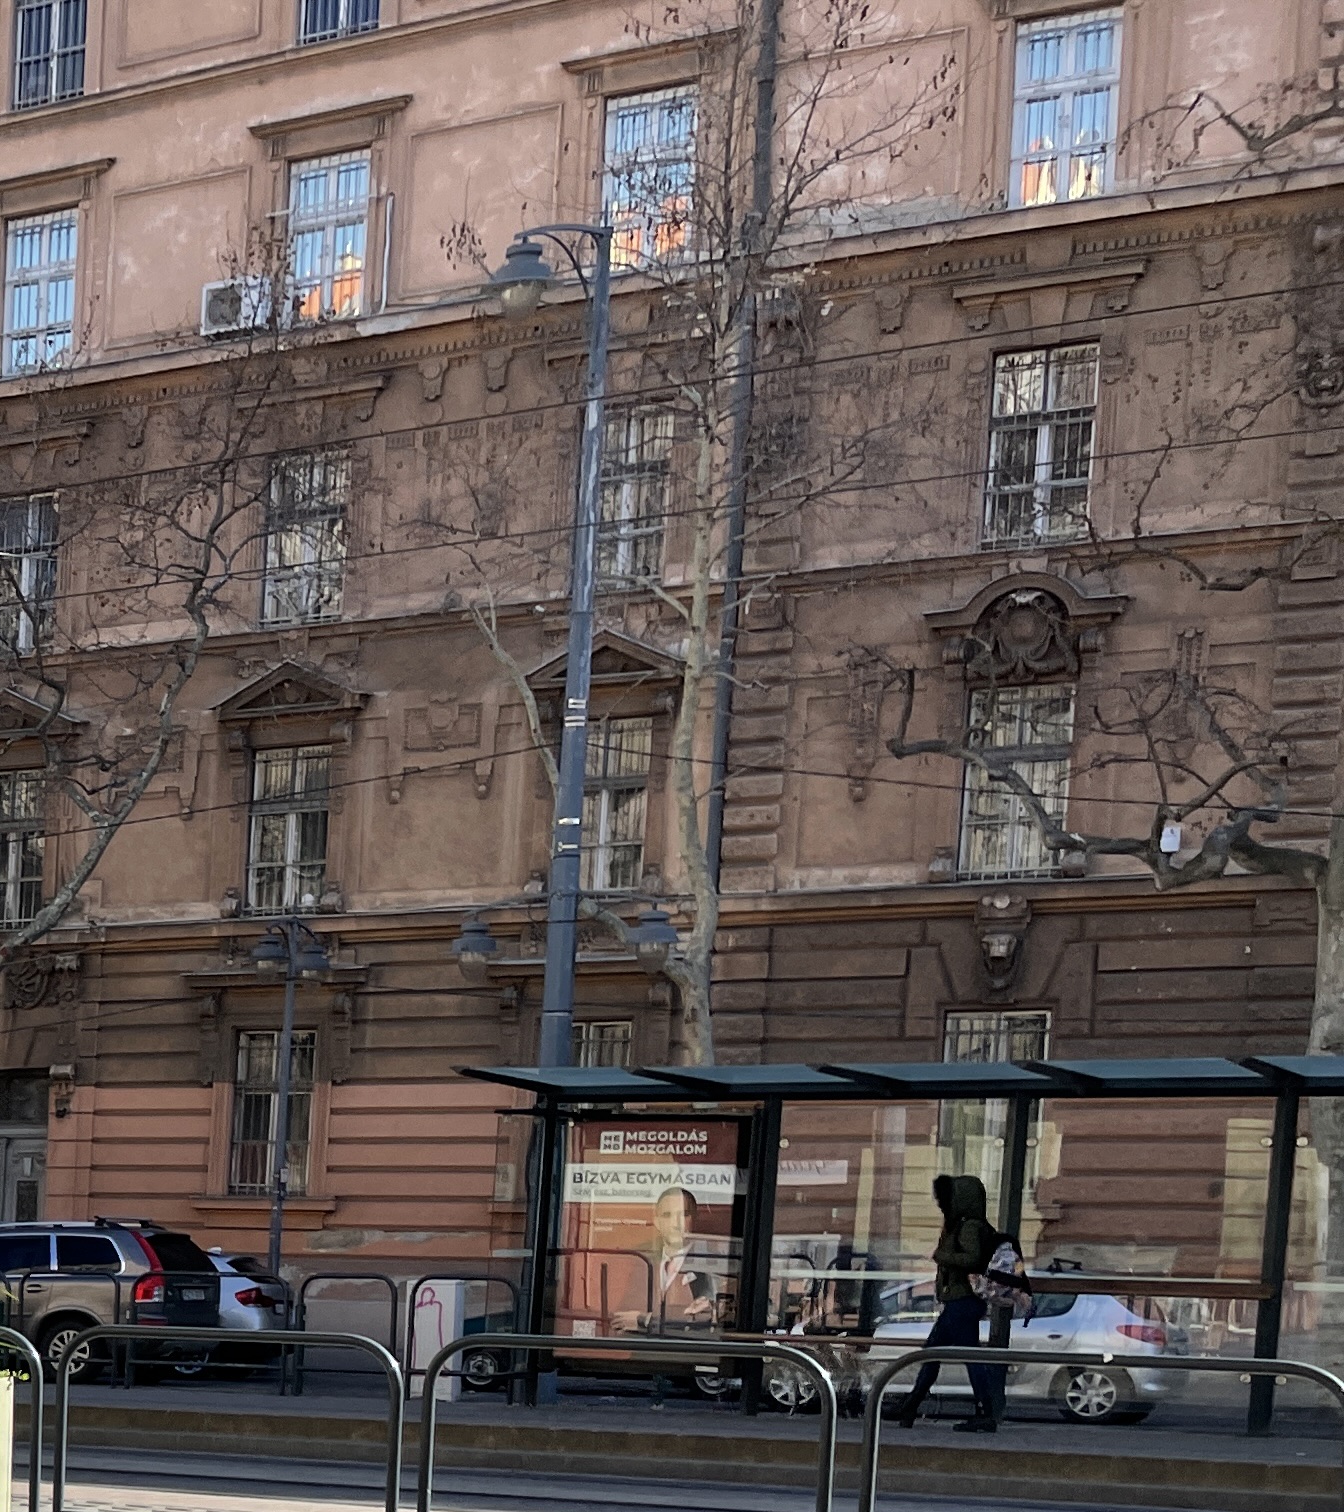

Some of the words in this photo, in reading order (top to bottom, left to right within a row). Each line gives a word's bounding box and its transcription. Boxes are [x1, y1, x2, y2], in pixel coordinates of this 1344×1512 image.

[625, 1129, 708, 1142] MEGOLDÁS
[624, 1143, 707, 1155] MOZGALOM
[572, 1170, 621, 1184] BÍZVA
[626, 1169, 731, 1185] EGYMÁSBAN
